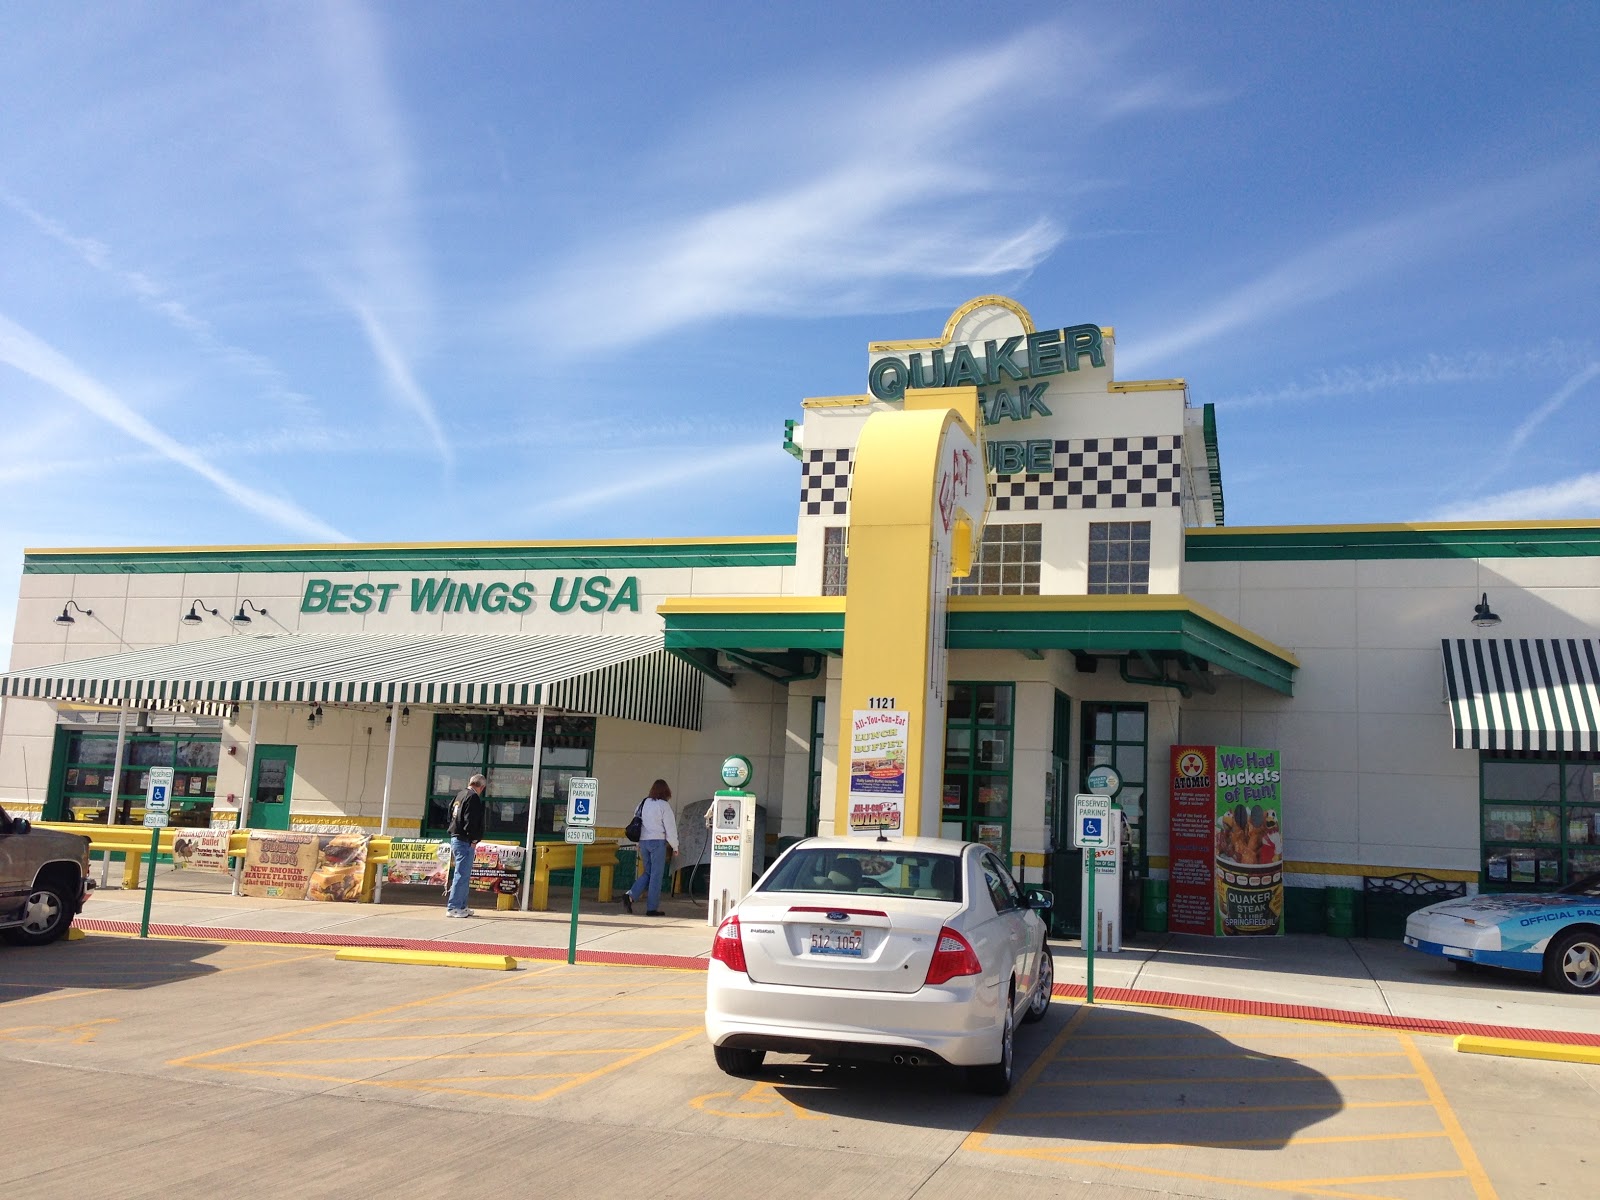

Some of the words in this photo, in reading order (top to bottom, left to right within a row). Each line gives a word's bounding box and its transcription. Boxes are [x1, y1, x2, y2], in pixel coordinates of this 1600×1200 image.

[869, 323, 1106, 401] QUAKER
[301, 579, 399, 613] BEST
[411, 578, 534, 613] WINGS
[549, 576, 639, 613] USA
[869, 697, 895, 709] 1121
[855, 729, 898, 741] LUNCH
[854, 740, 904, 753] BUFFET
[1220, 753, 1244, 771] We
[1246, 752, 1275, 769] Had
[1174, 776, 1211, 789] ATOMIC
[1217, 768, 1280, 788] Buckets
[1224, 787, 1241, 803] of
[1243, 784, 1276, 802] Fun!
[1077, 799, 1108, 807] RESERVED
[1079, 808, 1106, 816] PARKING
[567, 831, 580, 839] $250
[582, 831, 593, 840] FINE
[715, 835, 739, 844] Save
[391, 843, 410, 851] QUICK
[411, 844, 426, 852] LUBE
[412, 852, 433, 860] BUFFET
[245, 872, 271, 880] HAUTE
[272, 873, 309, 882] FLAVORS
[1228, 892, 1271, 905] QUAKER
[1237, 904, 1266, 913] STEAK
[1225, 918, 1266, 926] SPRINGFIELD
[1520, 912, 1575, 927] OFFICIAL
[811, 934, 830, 949] 512
[837, 936, 861, 950] 1052
